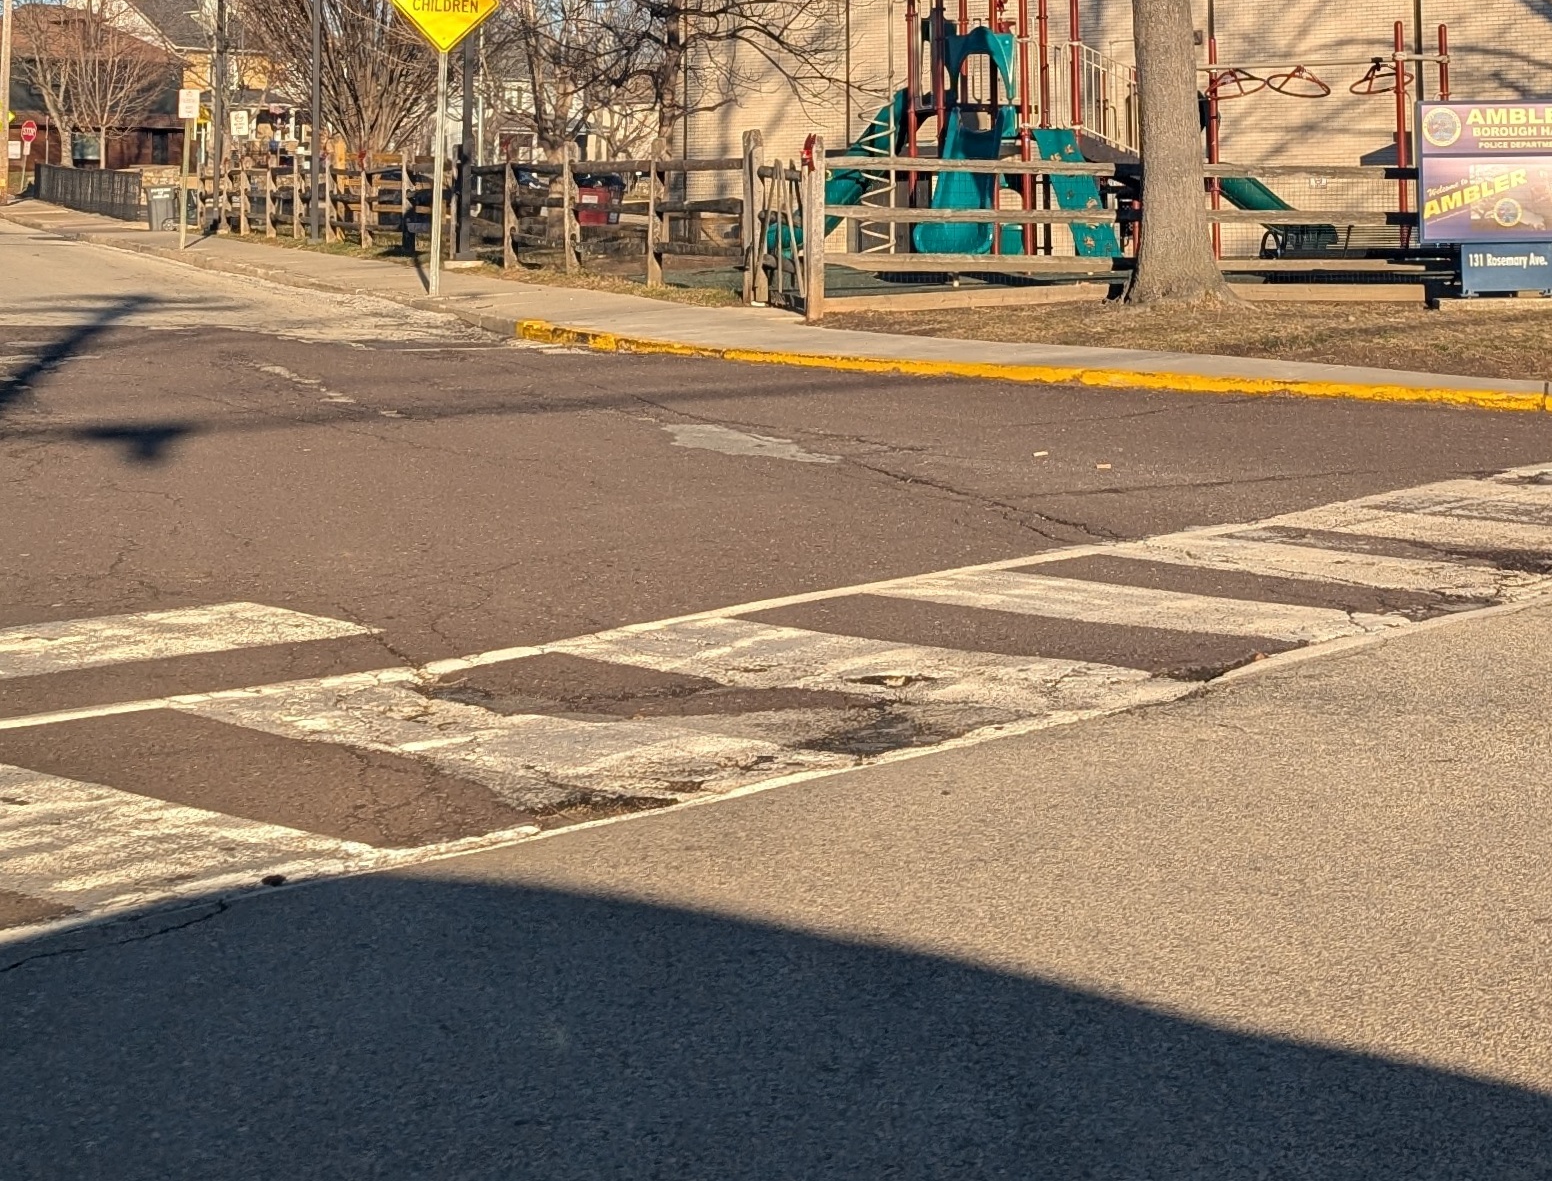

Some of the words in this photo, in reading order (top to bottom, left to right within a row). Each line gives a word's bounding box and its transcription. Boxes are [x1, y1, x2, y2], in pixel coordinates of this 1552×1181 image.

[1472, 126, 1537, 137] BOROUGH
[1478, 141, 1508, 149] POLICE
[1460, 178, 1468, 186] to
[1423, 168, 1528, 220] AMBLER
[1468, 253, 1484, 268] 131
[1486, 253, 1528, 269] Rosemary
[1529, 252, 1549, 266] Ave.
